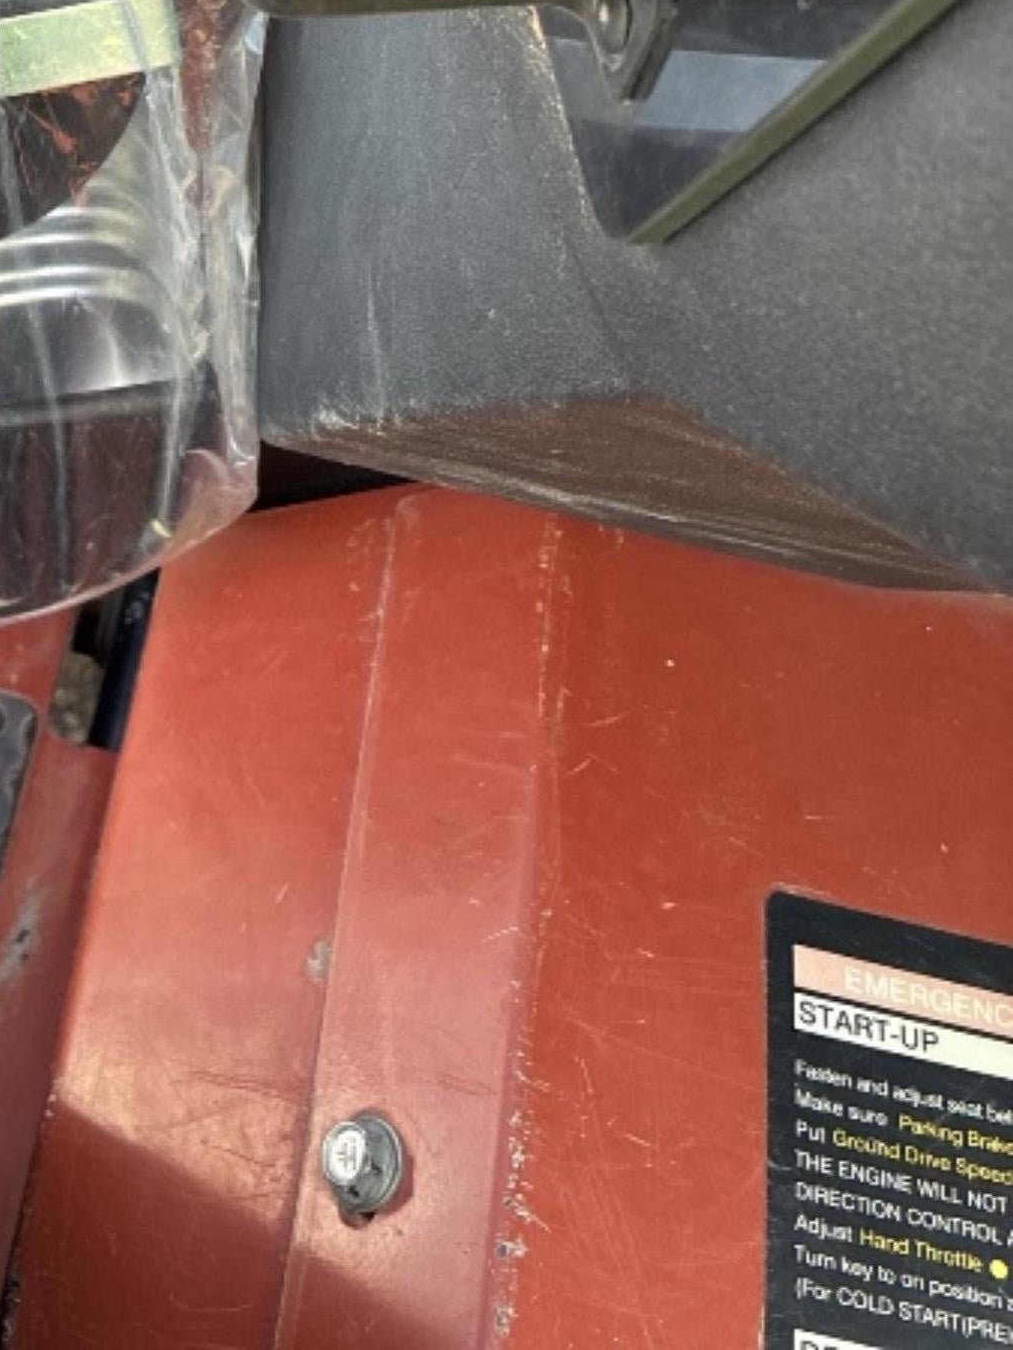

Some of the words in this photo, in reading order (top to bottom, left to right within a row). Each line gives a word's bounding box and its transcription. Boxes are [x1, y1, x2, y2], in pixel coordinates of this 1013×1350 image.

[799, 1000, 940, 1053] START-UP
[844, 965, 1013, 1027] EMERGENC
[794, 1058, 852, 1089] Fasten
[857, 1077, 888, 1097] and
[892, 1085, 944, 1111] adjust
[947, 1098, 984, 1120] seat
[794, 1087, 844, 1117] Make
[847, 1105, 888, 1126] sure
[898, 1113, 963, 1148] Parking
[832, 1128, 900, 1161] Ground
[904, 1145, 952, 1171] Drive
[794, 1149, 833, 1176] THE
[838, 1160, 913, 1194] ENGINE
[916, 1178, 963, 1205] WILL
[967, 1190, 1008, 1214] NOT
[794, 1181, 902, 1223] DIRECTION
[907, 1207, 1003, 1246] CONTROL
[794, 1213, 853, 1243] Adjust
[859, 1228, 910, 1256] Hand
[914, 1239, 984, 1273] Throttle
[794, 1244, 837, 1271] Turn
[841, 1256, 874, 1282] key
[877, 1265, 897, 1285] to
[901, 1273, 925, 1291] on
[929, 1280, 1004, 1310] position
[794, 1277, 833, 1302] (For
[836, 1286, 895, 1316] COLD
